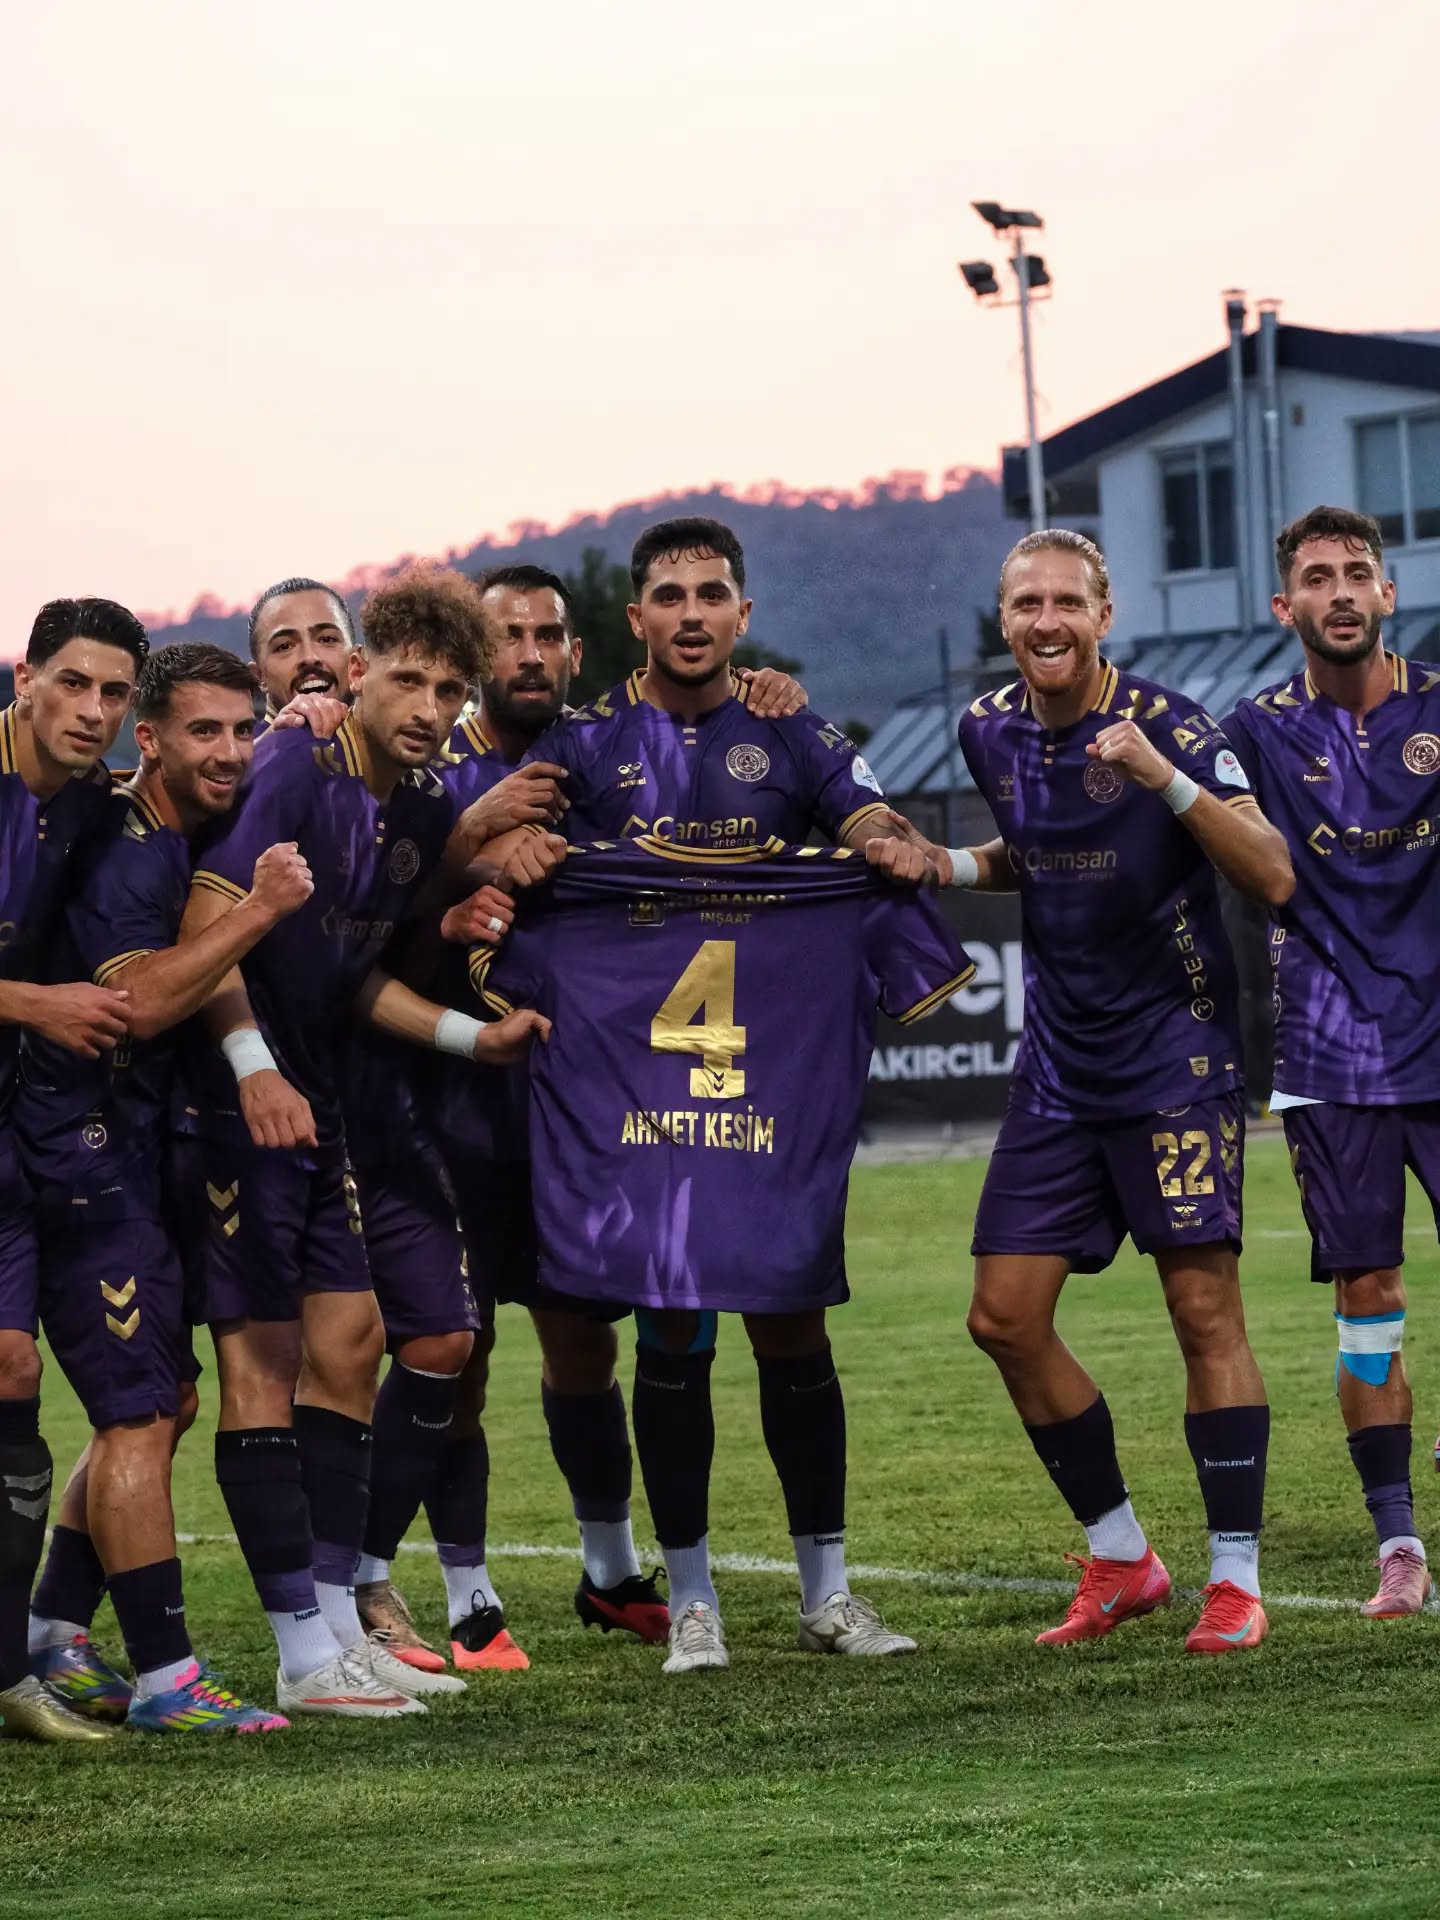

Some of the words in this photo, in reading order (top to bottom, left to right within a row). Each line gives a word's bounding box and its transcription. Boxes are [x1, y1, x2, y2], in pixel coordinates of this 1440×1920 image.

[650, 940, 747, 1099] 4
[621, 1111, 699, 1146] AHMET
[704, 1105, 775, 1153] KESİM
[1152, 1130, 1215, 1197] 22
[1204, 1456, 1254, 1468] hummel
